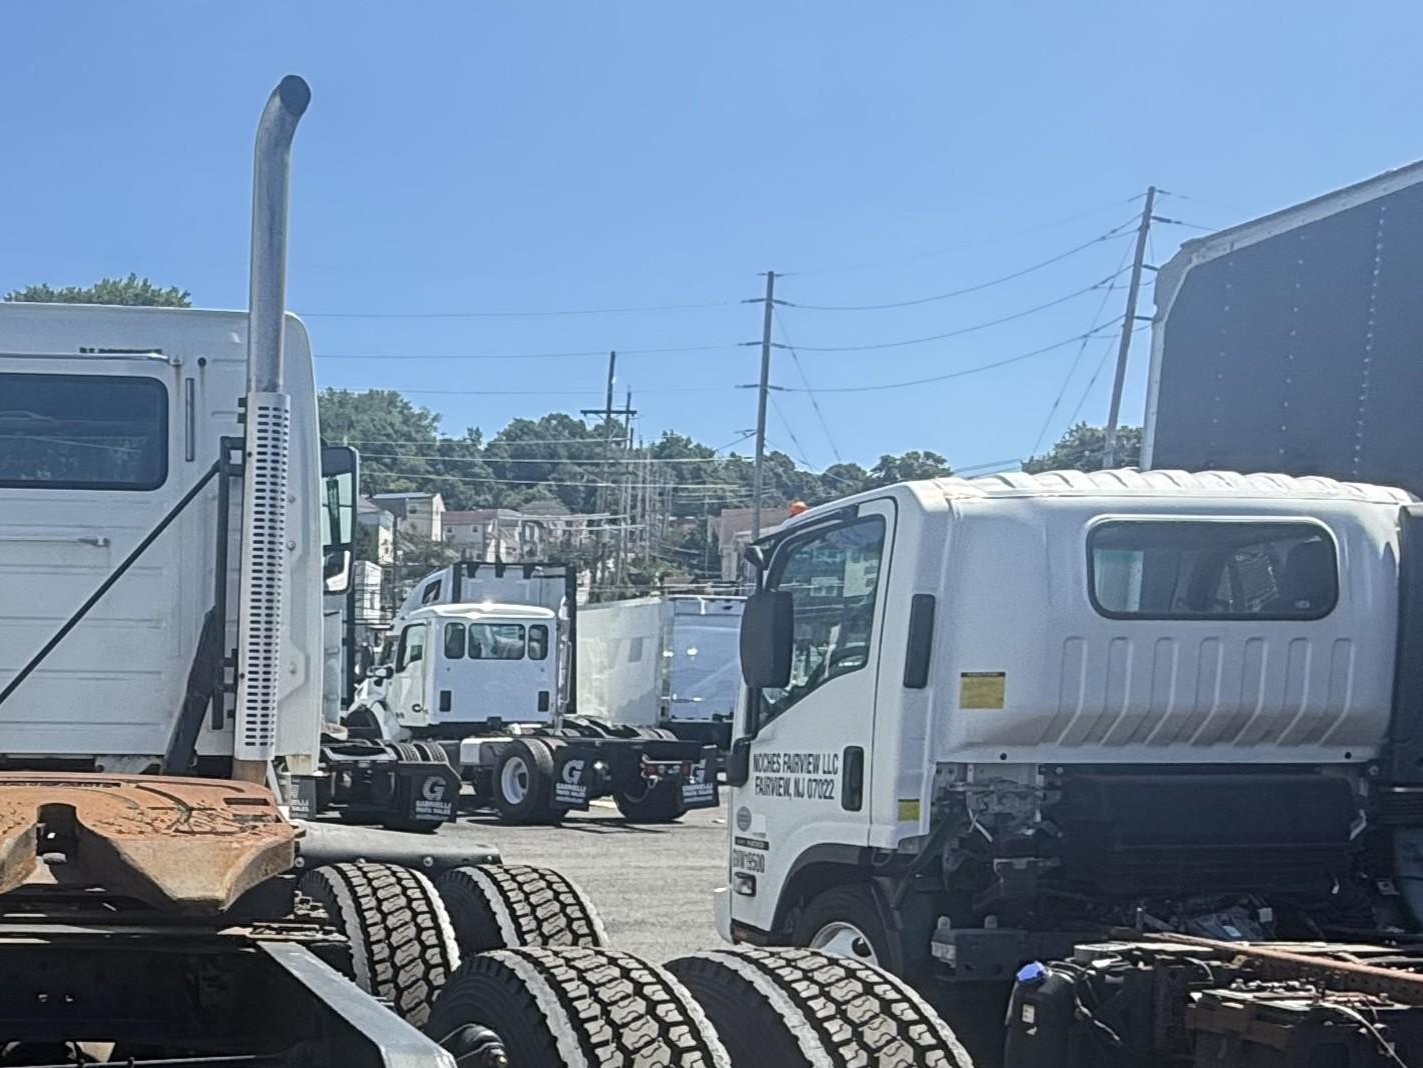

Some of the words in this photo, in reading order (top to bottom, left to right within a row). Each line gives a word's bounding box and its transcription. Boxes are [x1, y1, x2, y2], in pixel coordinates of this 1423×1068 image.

[783, 753, 820, 774] FAIRVIEW
[822, 753, 839, 775] LLC
[755, 776, 791, 801] FAIRVIEW,
[794, 777, 805, 799] NJ
[807, 778, 834, 800] 07022
